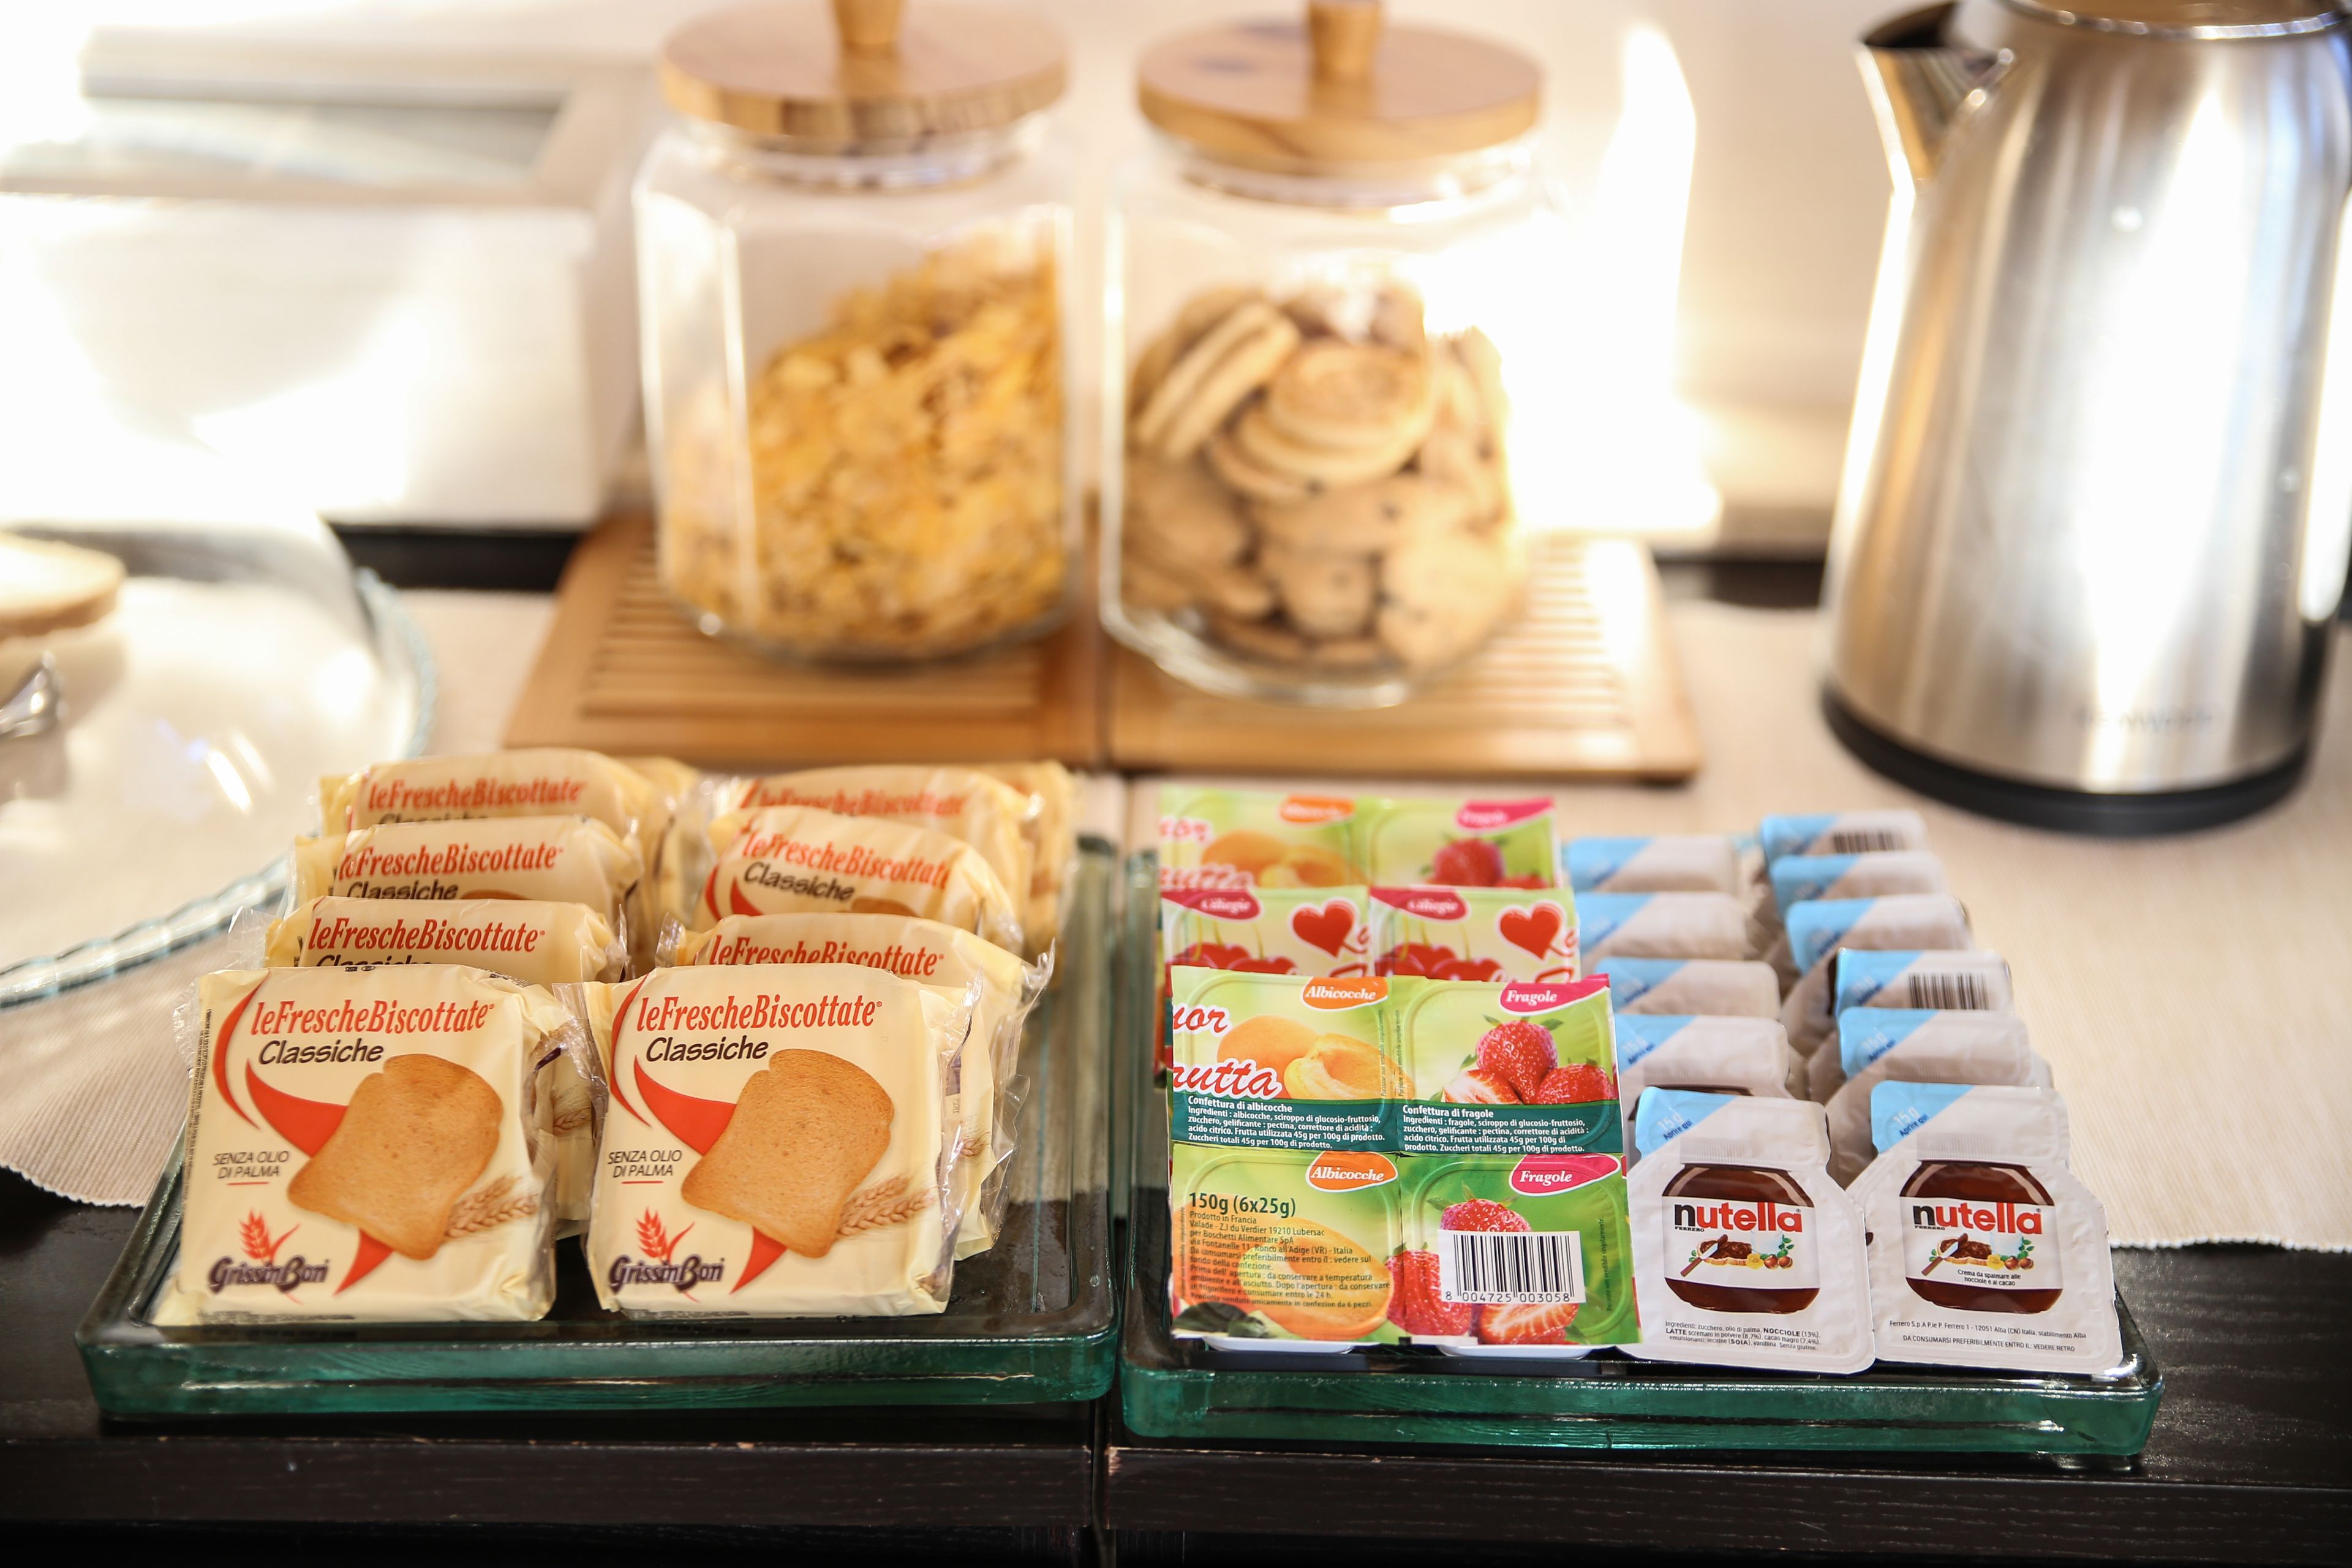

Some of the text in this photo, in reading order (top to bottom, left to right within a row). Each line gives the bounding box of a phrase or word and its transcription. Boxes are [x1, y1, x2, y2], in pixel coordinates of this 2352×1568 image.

[744, 861, 855, 902] Classiche
[307, 917, 538, 952] leFrescheBiscottate
[1305, 986, 1376, 1000] Albicocche
[1506, 990, 1557, 1006] Fragole
[251, 1000, 489, 1036] leFrescheBiscottate
[636, 993, 875, 1033] leFrescheBiscottate
[258, 1038, 384, 1065] Classiche
[646, 1036, 768, 1061] Classiche
[1188, 1095, 1292, 1112] Confettura di albicocche
[1188, 1106, 1381, 1124] Ingredienti albicocche, sciroppo glucosio-fruttosio,
[1403, 1104, 1493, 1120] Confettura di fragole
[1188, 1115, 1221, 1126] zucchero,
[1223, 1119, 1261, 1128] gelificante
[1403, 1115, 1442, 1125] Ingredienti
[1449, 1118, 1477, 1128] fragole,
[1518, 1118, 1585, 1128] glucosio-fruttosio,
[1209, 1126, 1233, 1135] citrico.
[1235, 1127, 1256, 1136] Frutta
[1259, 1129, 1292, 1137] utilizzata
[1323, 1132, 1341, 1142] 100g
[1351, 1133, 1385, 1142] prodotto.
[1403, 1125, 1437, 1134] zucchero,
[1439, 1127, 1477, 1136] gelificante
[1188, 1133, 1218, 1142] Zuccheri
[1242, 1137, 1255, 1146] 45g
[1270, 1138, 1288, 1148] 100g
[1298, 1140, 1332, 1148] prodotto.
[1404, 1143, 1438, 1152] prodotto.
[1522, 1145, 1540, 1153] 100g
[1550, 1144, 1585, 1153] prodotto.
[1510, 1136, 1523, 1145] 45g
[1539, 1136, 1557, 1145] 100g
[213, 1151, 290, 1166] SENZA OLIO
[608, 1150, 682, 1164] SENZA OLIO
[218, 1166, 280, 1178] DI PALMA
[613, 1164, 674, 1177] DI PALMA
[1311, 1166, 1384, 1181] Albicocche
[1520, 1170, 1572, 1186] Fragole
[1189, 1192, 1295, 1218] 150g (6x25g)
[1190, 1211, 1221, 1221] Prodotto
[1231, 1215, 1256, 1224] Francia
[1674, 1202, 1803, 1232] nutella
[1913, 1202, 2042, 1234] nutella
[1190, 1220, 1324, 1235] Valade Verdier 19210 Lubersac
[1203, 1238, 1240, 1250] Fontanelle
[1204, 1230, 1236, 1241] Boschetti
[1238, 1234, 1278, 1243] Alimentare
[1280, 1236, 1294, 1245] SpA
[1446, 1291, 1570, 1303] 8 004725 003058
[1665, 1321, 1697, 1329] Ingredienti:
[1763, 1327, 1800, 1336] NOCCIOLE
[1953, 1337, 2003, 1347] PREFERIBILMENTE
